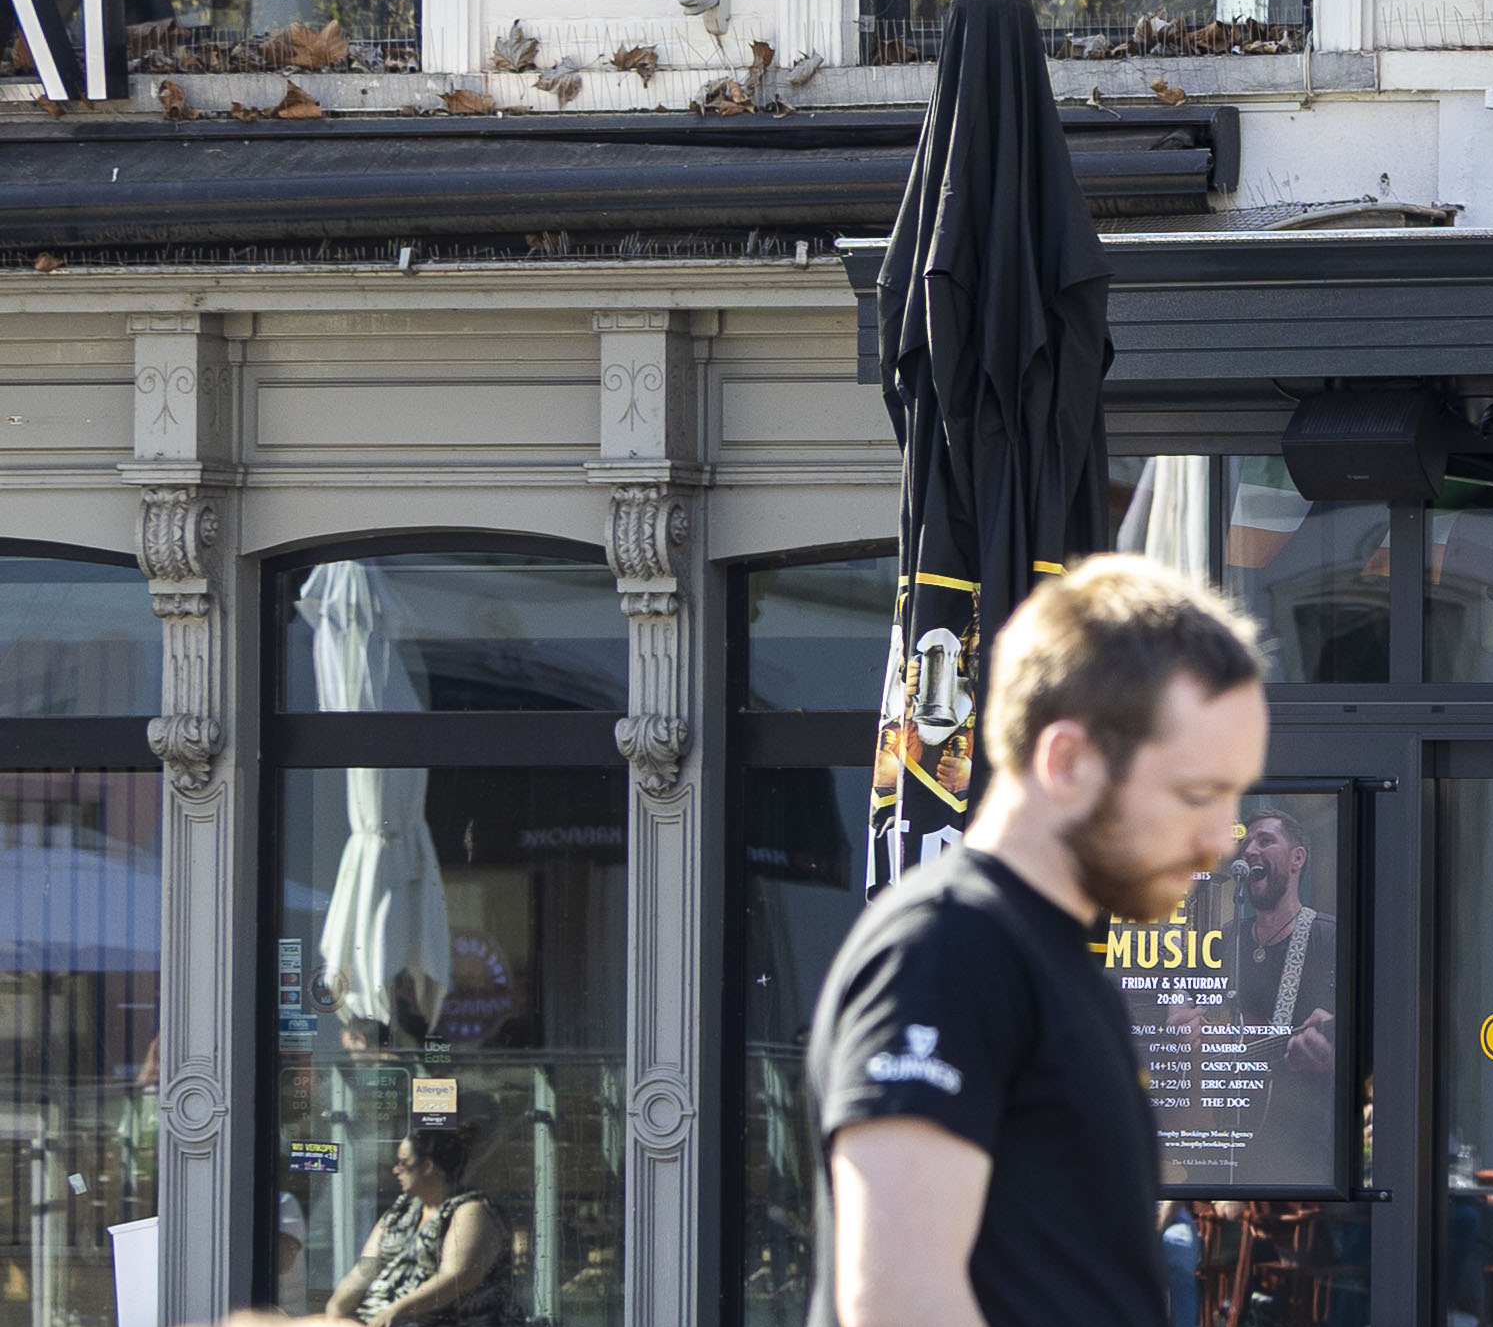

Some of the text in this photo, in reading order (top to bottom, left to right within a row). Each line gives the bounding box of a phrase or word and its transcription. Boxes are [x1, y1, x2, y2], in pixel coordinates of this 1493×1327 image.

[1105, 930, 1223, 969] MUSIC
[1121, 976, 1229, 990] FRIDAY & SATURDAY
[1156, 993, 1223, 1005] 20:00 23:00
[1131, 1023, 1293, 1036] 28/02 01/03 CIARÁN SWEENEY
[424, 1041, 452, 1052] Uber
[1149, 1043, 1248, 1053] 07+08/03 DAMBRO
[424, 1053, 451, 1064] Eats
[1150, 1061, 1269, 1073] 14+15/03 CASEY JONES
[1150, 1079, 1264, 1090] 21+22/03 ERIC ABTAN
[1201, 1097, 1251, 1108] THE DOC
